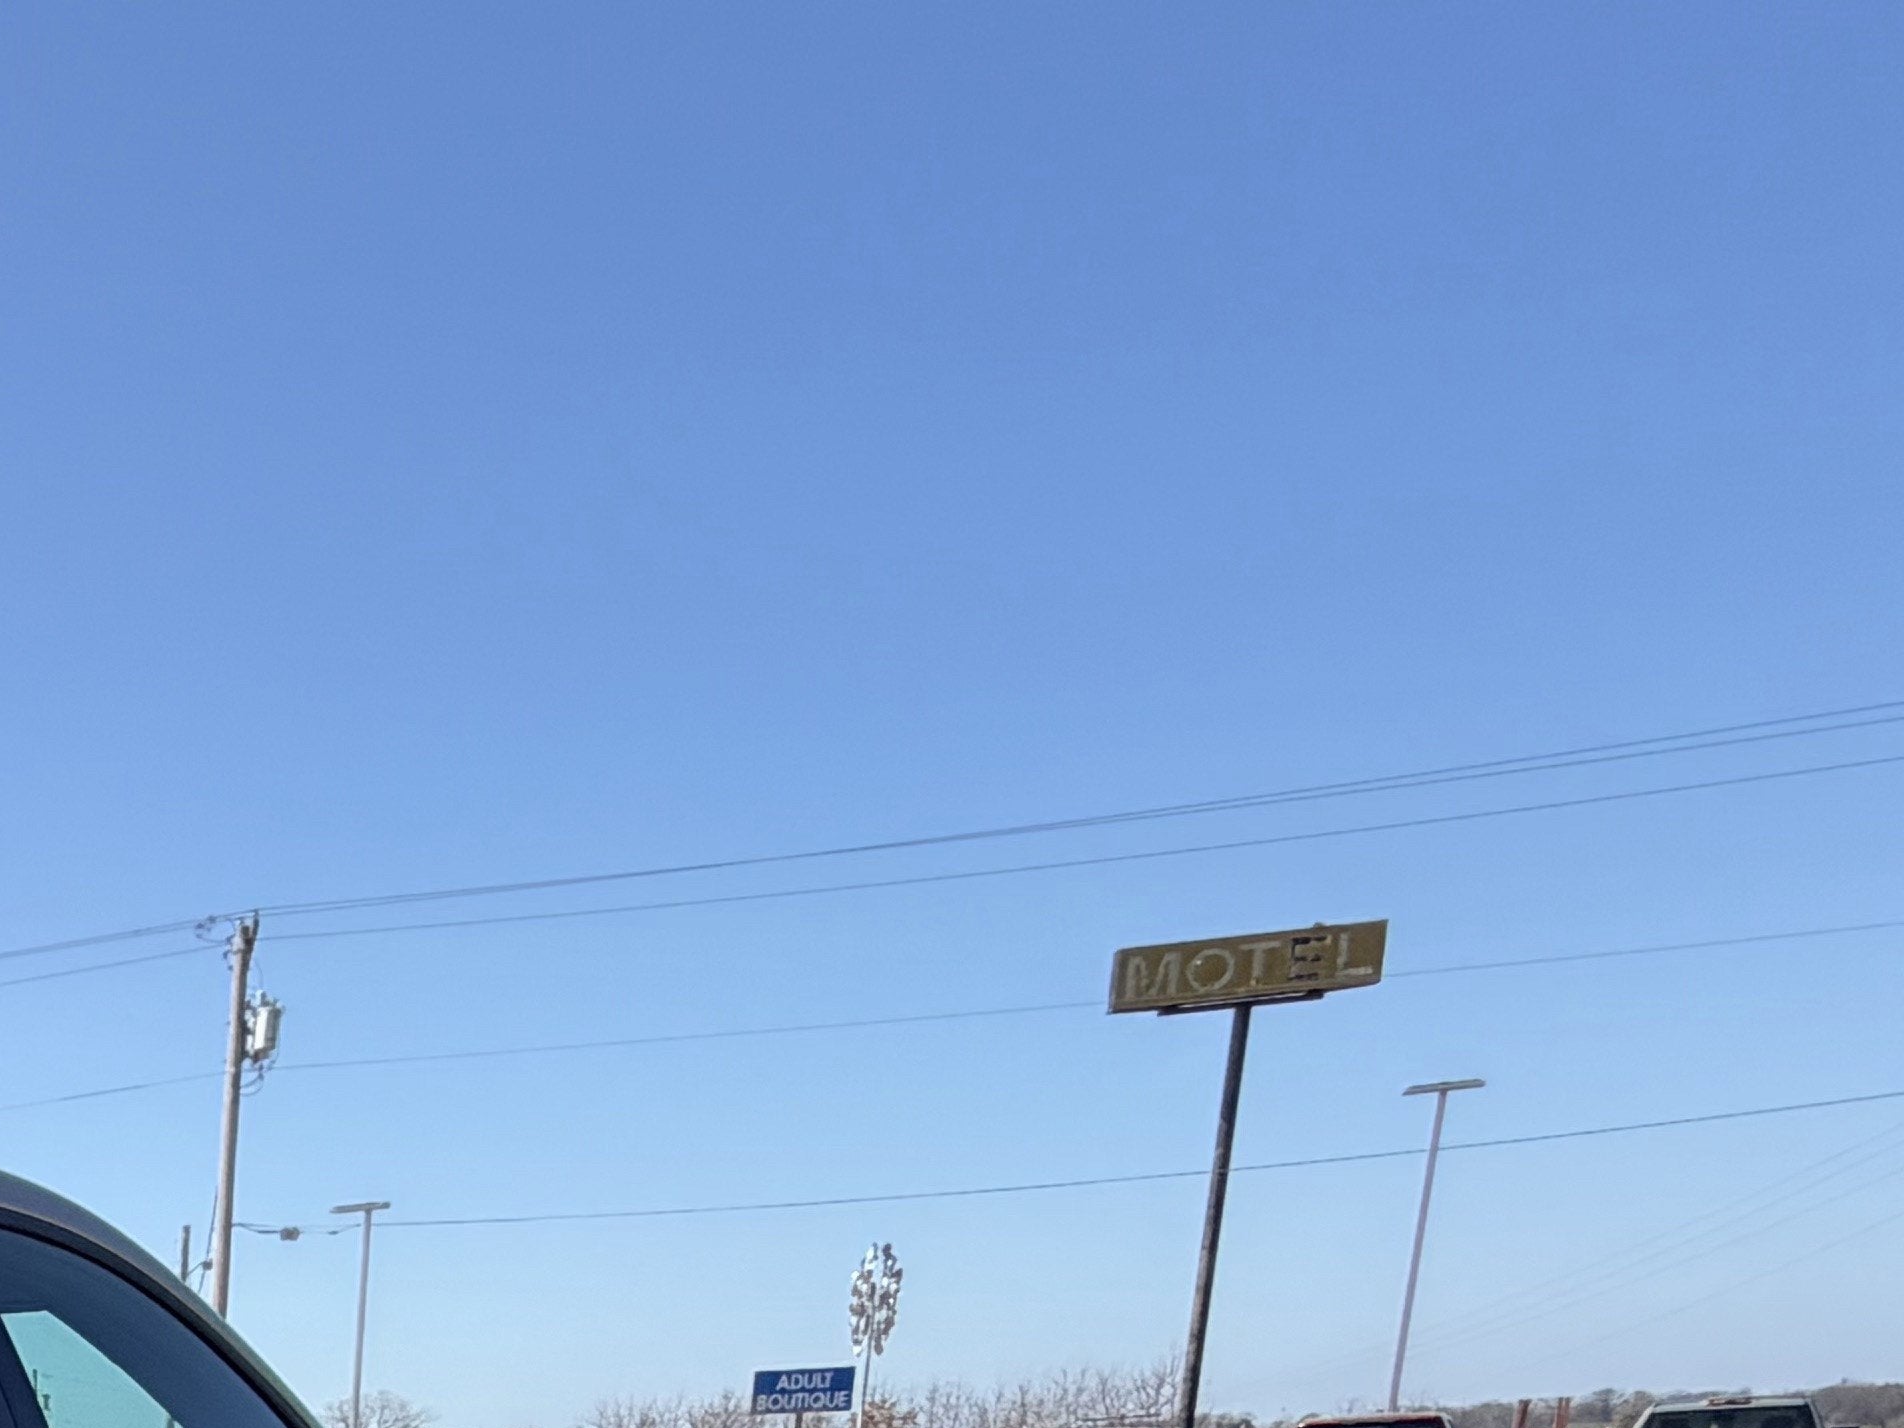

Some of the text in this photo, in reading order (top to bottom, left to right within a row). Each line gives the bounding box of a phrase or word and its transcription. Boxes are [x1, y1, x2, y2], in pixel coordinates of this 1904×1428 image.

[1123, 931, 1374, 1000] MOTEL
[775, 1370, 835, 1391] ADULT
[756, 1390, 850, 1411] BOUTIQUE
